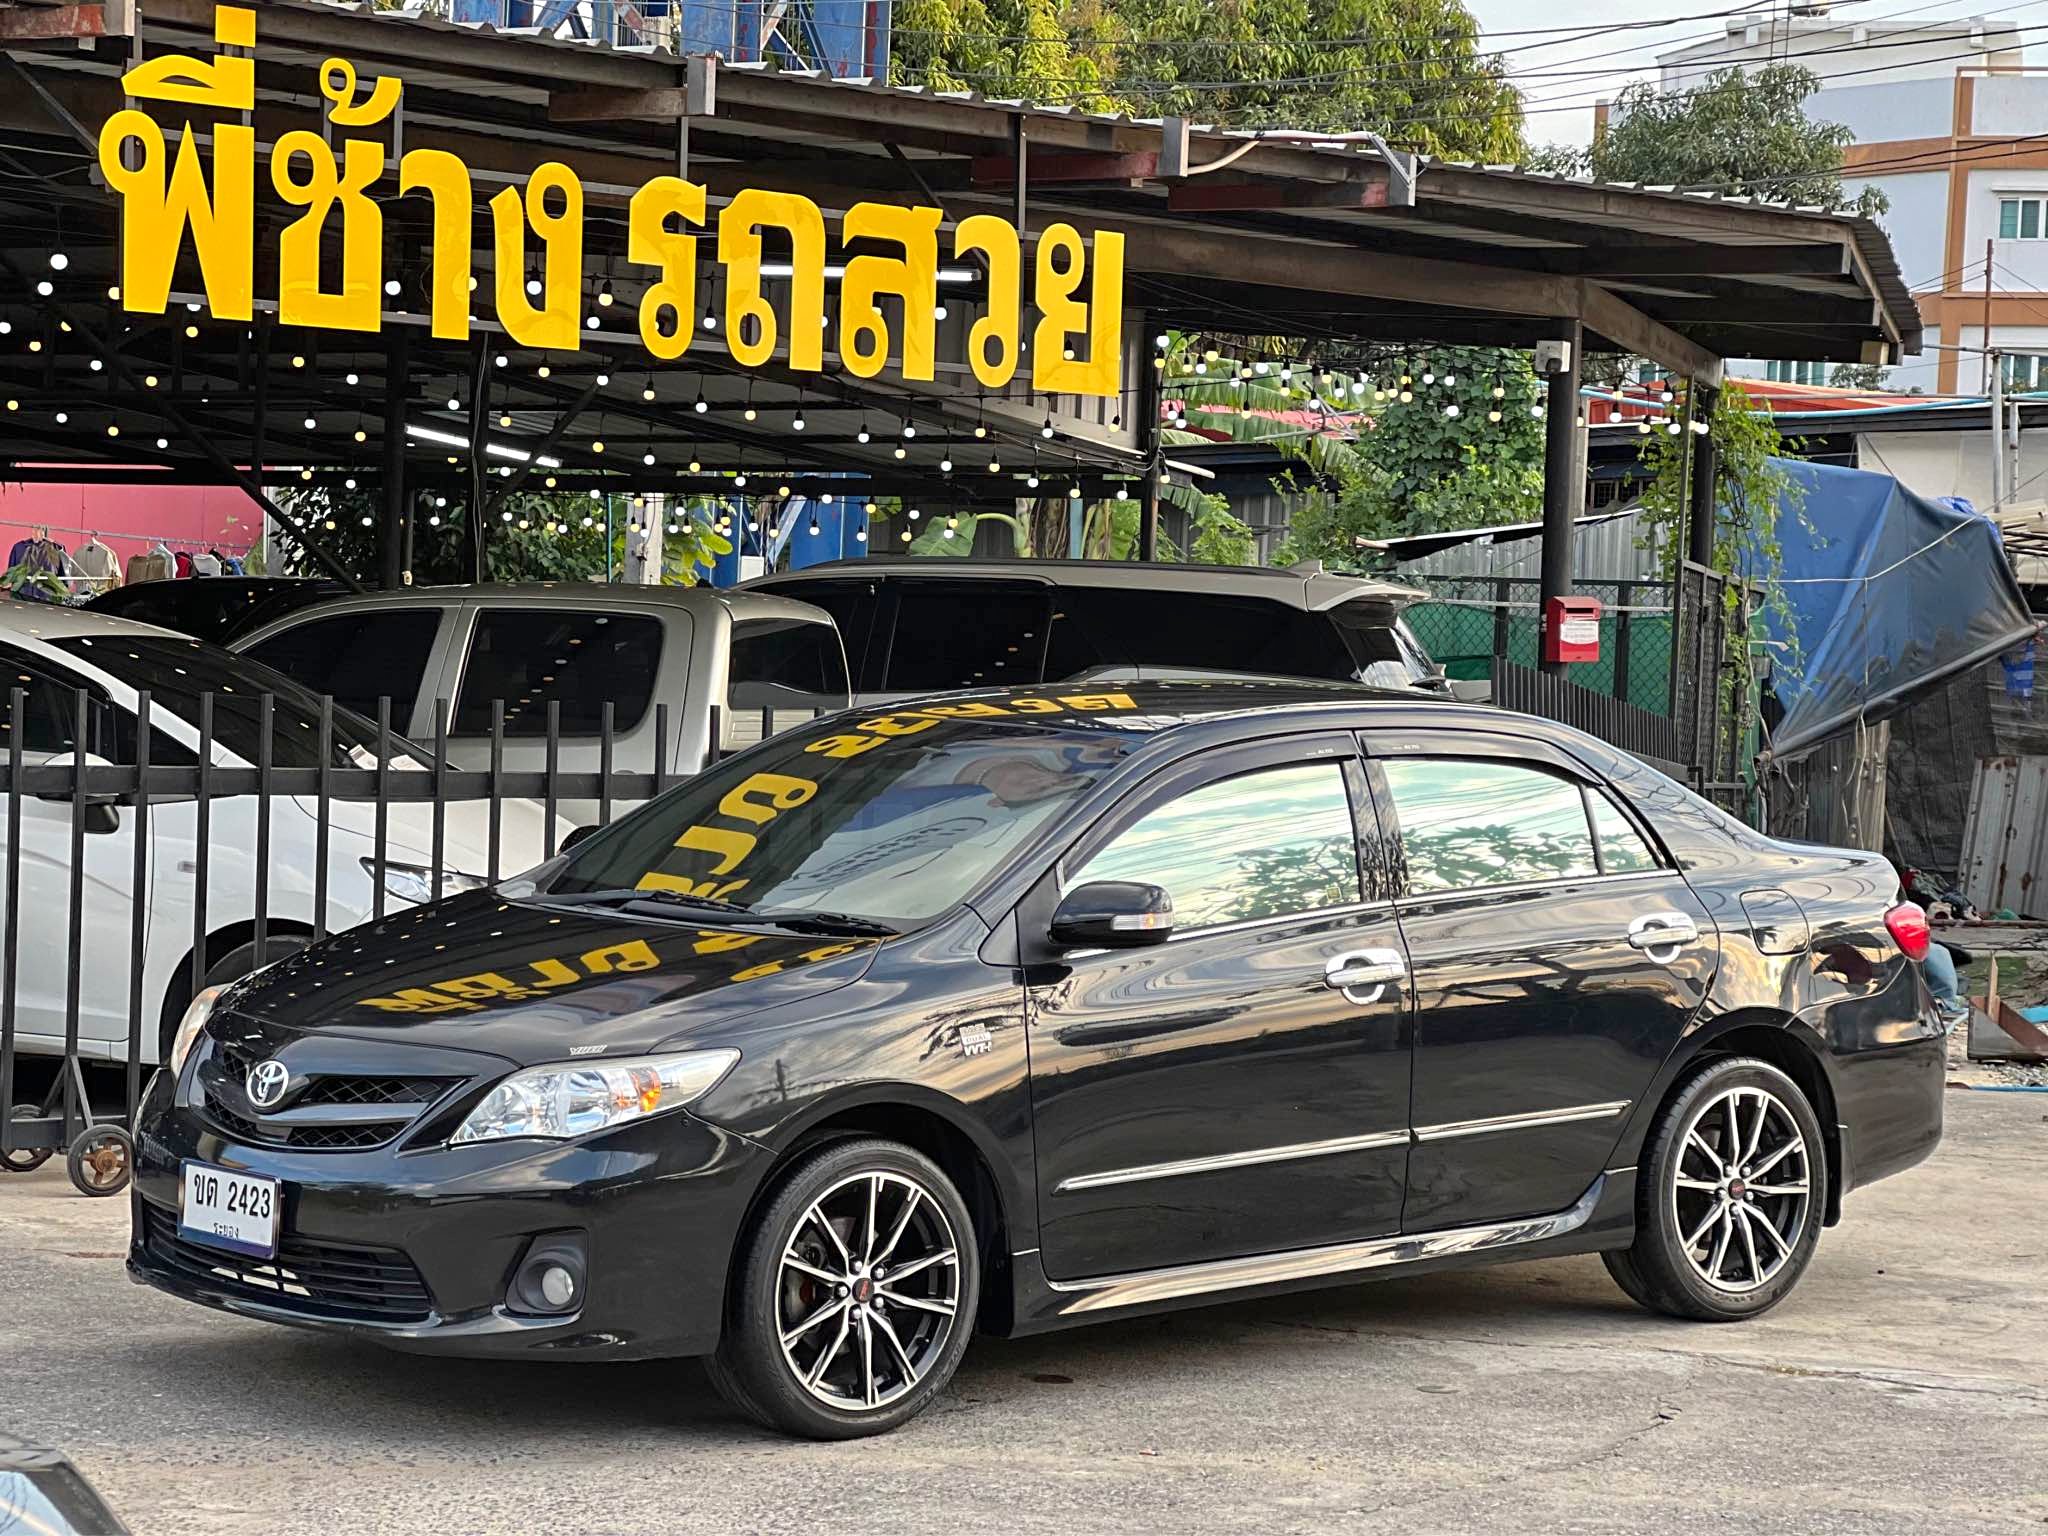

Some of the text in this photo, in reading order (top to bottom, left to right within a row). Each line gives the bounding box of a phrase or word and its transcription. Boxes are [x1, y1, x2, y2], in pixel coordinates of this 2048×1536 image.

[98, 5, 1125, 399] พี่ช้าง รถสวย
[227, 1181, 271, 1219] 2423
